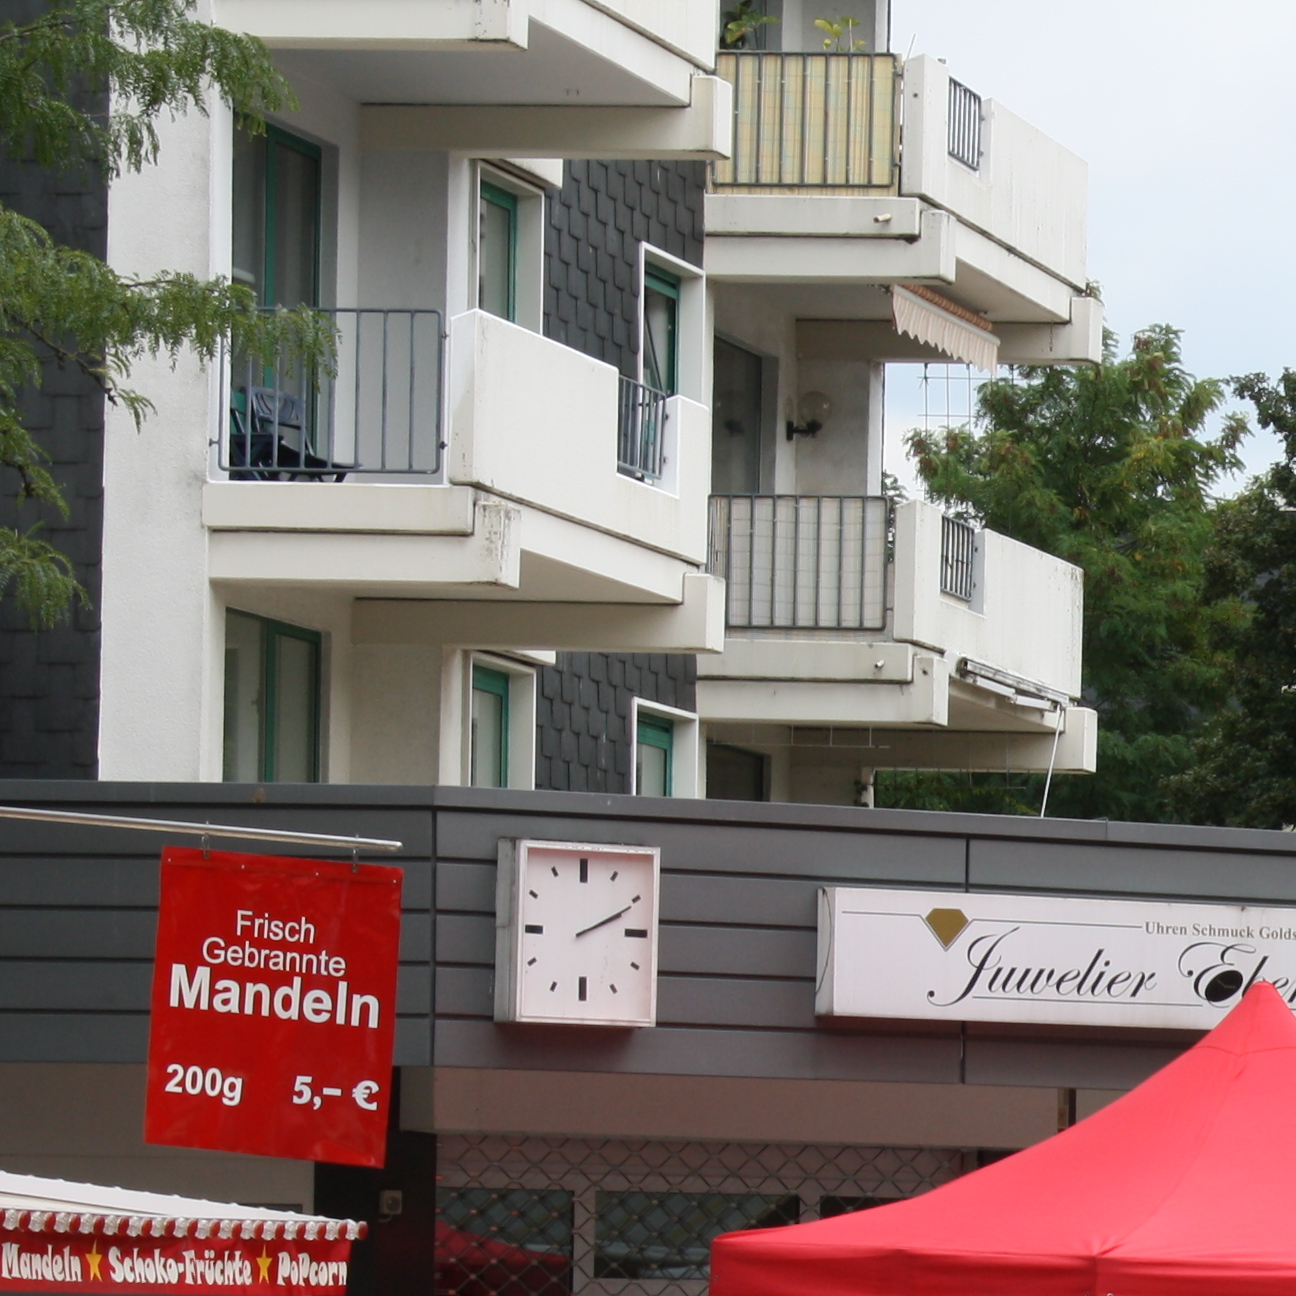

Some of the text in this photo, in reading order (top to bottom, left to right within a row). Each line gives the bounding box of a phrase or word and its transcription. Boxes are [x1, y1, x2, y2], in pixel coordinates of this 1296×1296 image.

[235, 910, 316, 944] Frisch
[1145, 921, 1187, 937] Uhren
[1192, 923, 1255, 939] Schmuck
[202, 936, 347, 977] Gebrannte
[927, 926, 1156, 1006] Juwelier
[169, 963, 380, 1028] Mandeln
[164, 1064, 243, 1105] 200g
[351, 1080, 380, 1111] €
[1, 1242, 82, 1282] Mandeln
[108, 1246, 252, 1286] Schoko-Früchte
